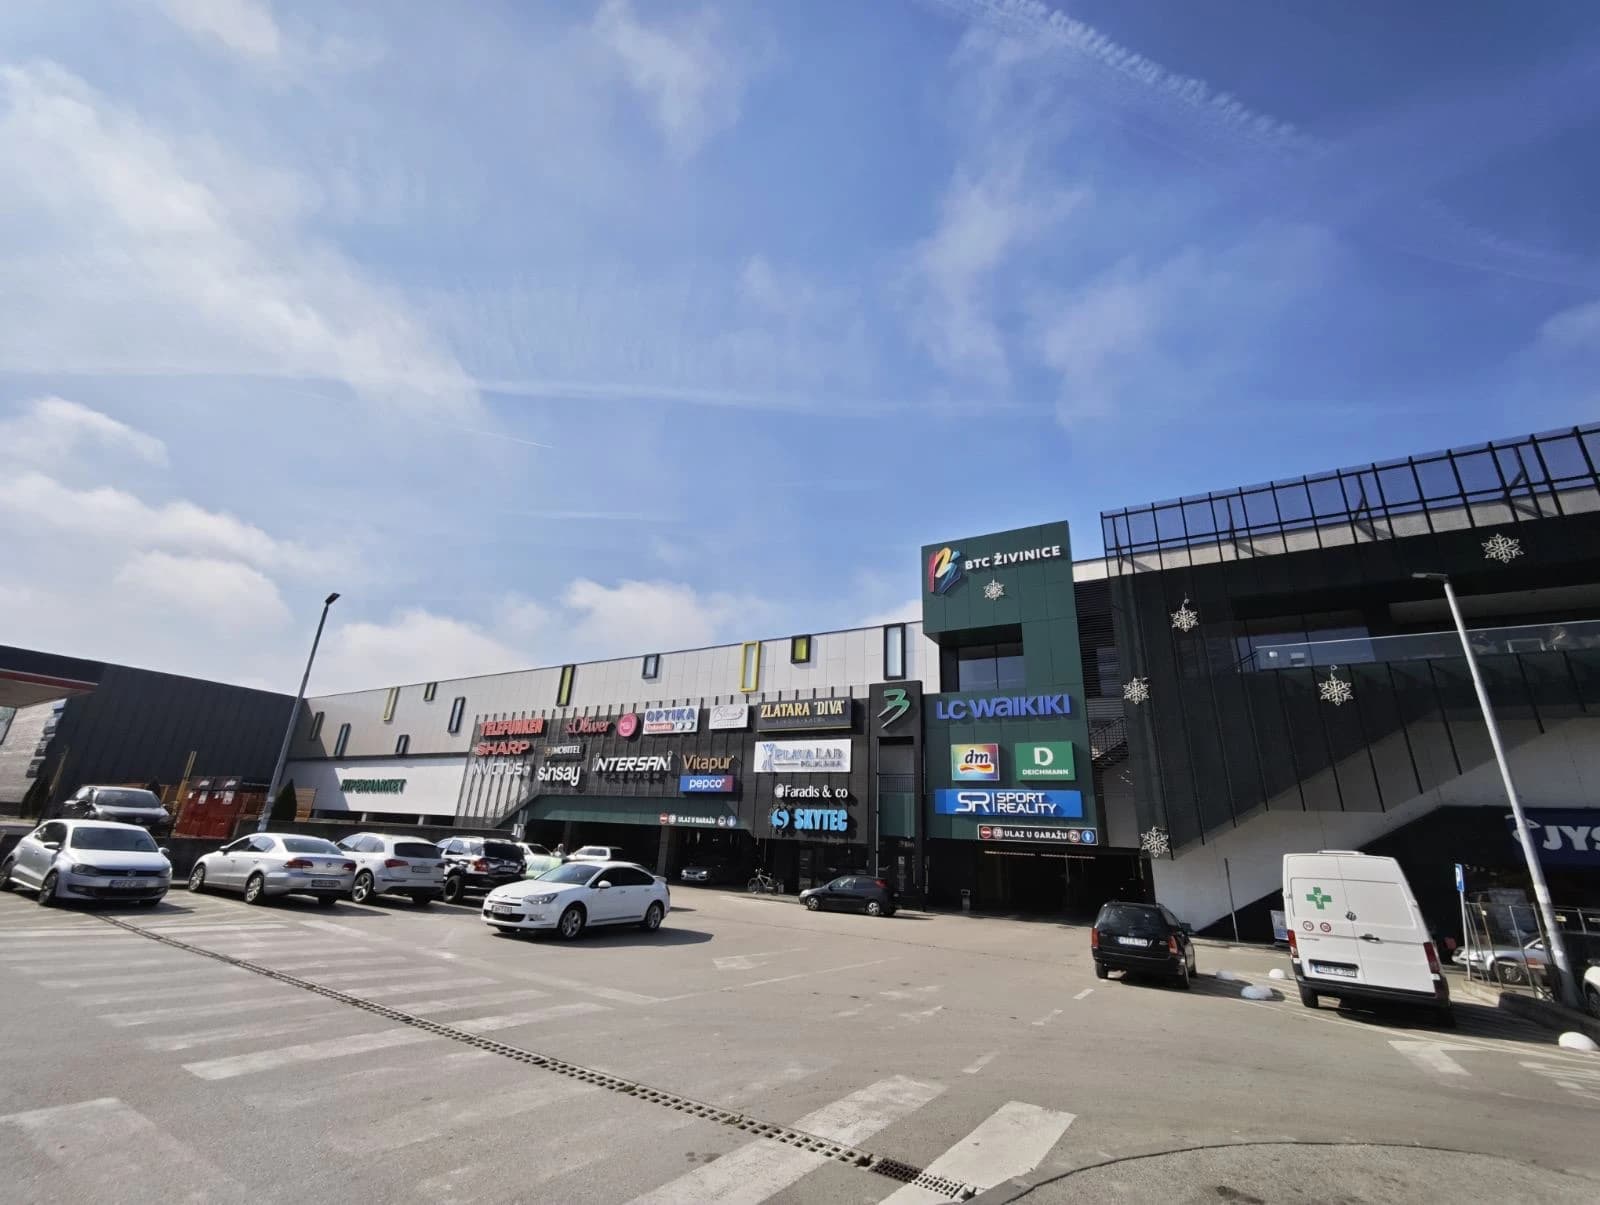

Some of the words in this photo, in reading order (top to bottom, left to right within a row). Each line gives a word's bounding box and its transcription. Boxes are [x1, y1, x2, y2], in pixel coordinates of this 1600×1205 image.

[964, 556, 991, 570] BTC
[993, 545, 1062, 566] ŽIVINICE
[646, 707, 696, 722] OPTIKA
[760, 702, 811, 719] ZLATARA
[936, 700, 966, 720] LC
[479, 717, 545, 736] TELEFUNKEN
[565, 715, 611, 734] s.Oliver
[475, 740, 530, 756] SHARP
[1033, 746, 1054, 767] D
[682, 754, 732, 774] Vitapur
[964, 749, 990, 765] dm
[537, 761, 581, 787] sinsay
[1021, 768, 1069, 776] DEICHMANN
[689, 777, 723, 790] pepco
[784, 784, 820, 798] Faradis
[821, 784, 833, 798] &
[835, 787, 849, 798] co
[955, 791, 991, 813] SR
[996, 791, 1045, 804] SPORT
[996, 802, 1057, 814] REALITY
[793, 808, 849, 831] SKYTEC
[1004, 829, 1025, 838] ULAZ
[1026, 830, 1032, 838] U
[1034, 828, 1068, 840] GARAŽU
